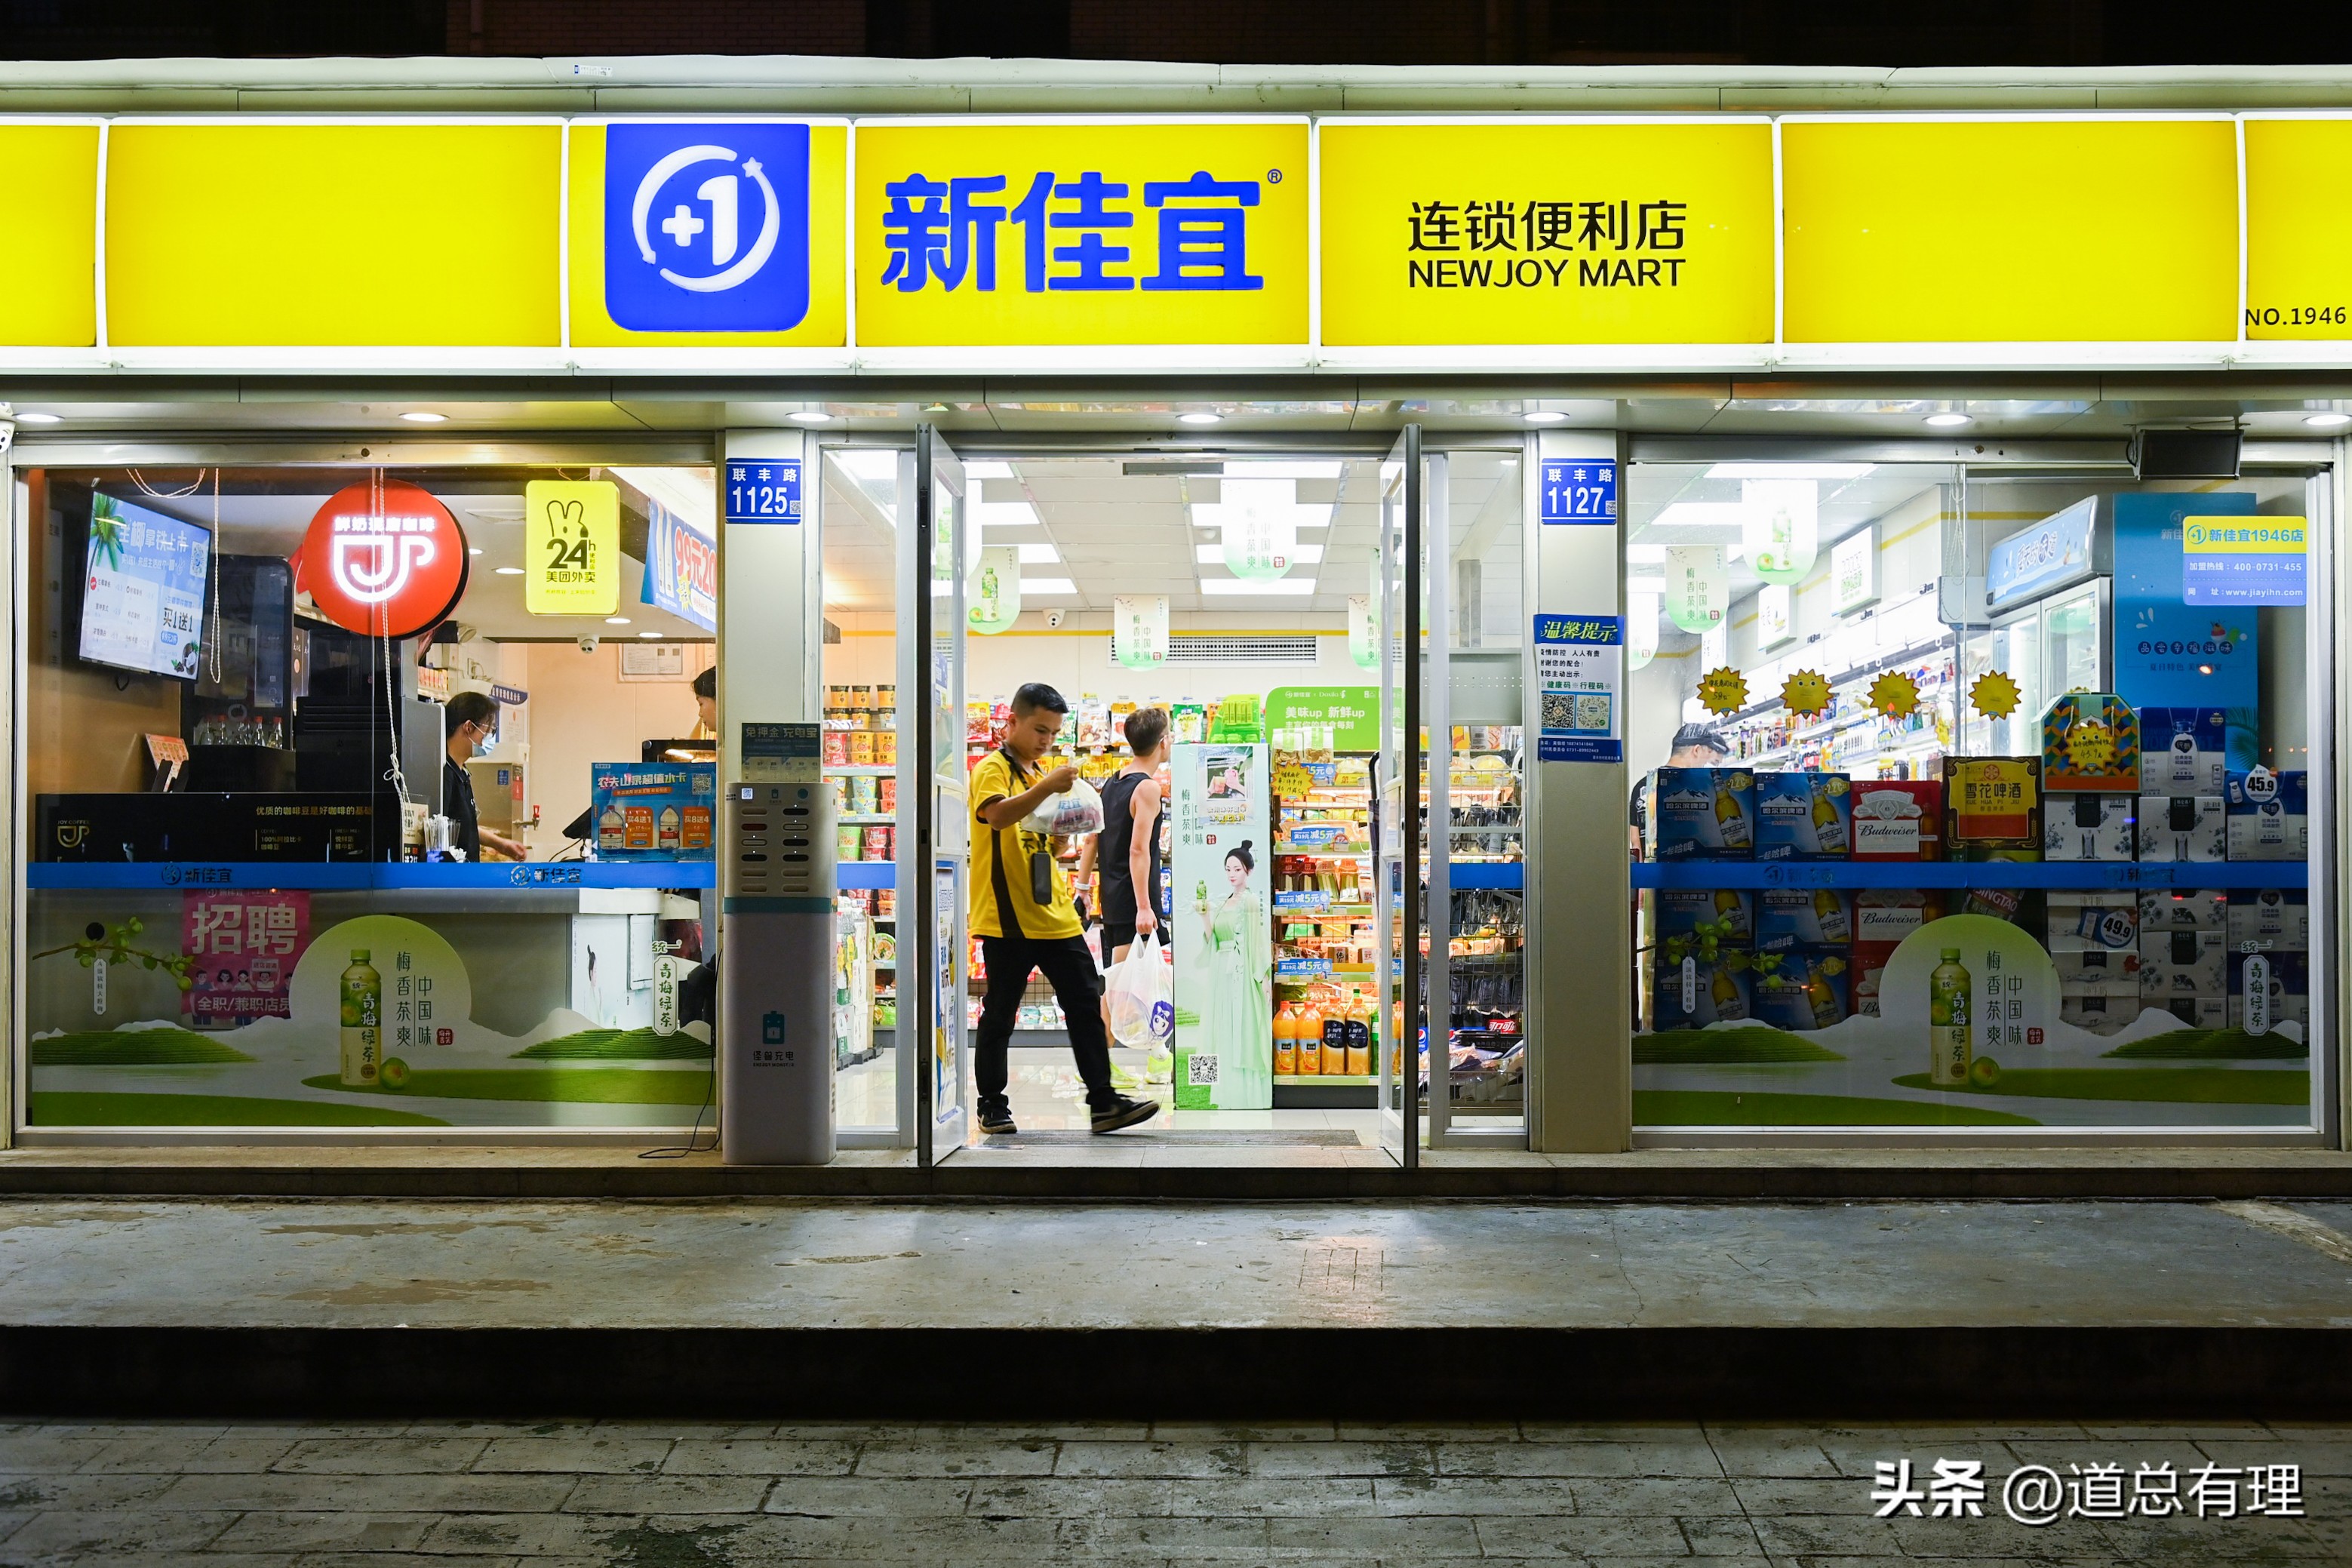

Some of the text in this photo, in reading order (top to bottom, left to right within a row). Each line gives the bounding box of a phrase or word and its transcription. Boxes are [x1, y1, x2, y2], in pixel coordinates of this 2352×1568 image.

[881, 171, 1264, 292] 新佳宜
[1408, 200, 1686, 251] 连锁便利店
[1410, 260, 1686, 287] NEWJOY MART
[2246, 306, 2346, 326] NO.1946
[732, 468, 797, 482] 联丰路
[1548, 468, 1613, 482] 联丰路
[733, 486, 787, 514] 1125
[1548, 487, 1603, 514] 1127
[2209, 529, 2304, 542] 新佳宜1946店
[2234, 563, 2301, 571] 400-0731-455
[546, 571, 595, 583] 美团外卖
[163, 607, 193, 632] 买1送1
[1541, 621, 1618, 641] 温馨提示
[1286, 706, 1365, 719] 美味up 新鲜up
[746, 727, 817, 738] 免押金 充电宝
[598, 772, 686, 788] 农夫山泉超值水卡
[2247, 776, 2274, 792] 45.9
[1966, 782, 2021, 798] 雪花啤酒
[256, 806, 373, 816] 优质的咖啡豆是好咖啡的基础
[1181, 789, 1191, 846] 梅香茶爽
[1310, 830, 1335, 839] 减5元
[1858, 824, 1917, 837] Budweiser
[185, 869, 232, 883] 新佳宜
[534, 868, 581, 883] 新佳宜
[1295, 894, 1320, 902] 减5元
[1973, 889, 2018, 912] SINGTAO
[1861, 912, 1920, 924] Budweiser
[192, 902, 298, 955] 招聘
[2103, 918, 2131, 938] 49.9
[652, 942, 679, 953] 统一
[2242, 942, 2271, 953] 统一
[1297, 961, 1321, 970] 减5元
[396, 951, 410, 1047] 梅香茶爽
[659, 962, 673, 1027] 青梅绿茶
[1987, 951, 2000, 1046] 梅香茶爽
[2250, 962, 2264, 1026] 青梅绿茶
[198, 997, 290, 1012] 全职/兼职店员
[418, 976, 432, 1047] 中国味
[2009, 975, 2021, 1046] 中国味
[361, 992, 377, 1062] 青梅绿茶
[1952, 991, 1966, 1061] 青梅绿茶
[753, 1050, 794, 1061] 怪兽充电
